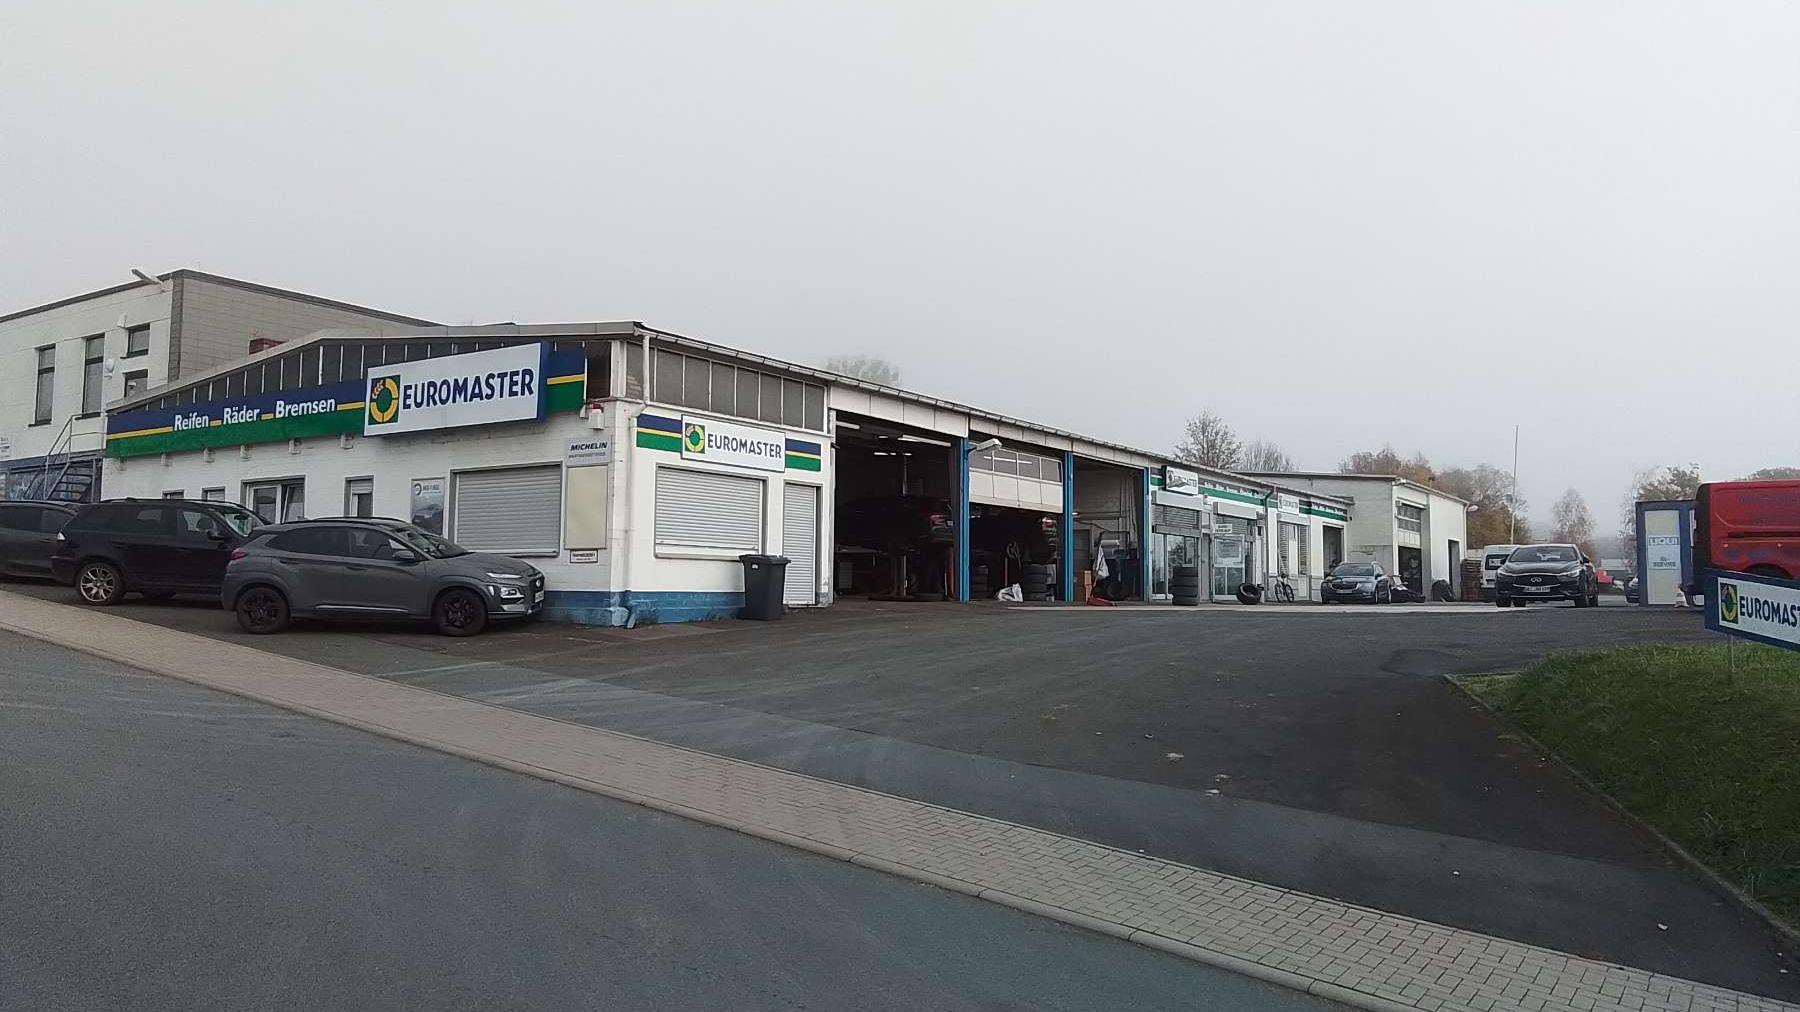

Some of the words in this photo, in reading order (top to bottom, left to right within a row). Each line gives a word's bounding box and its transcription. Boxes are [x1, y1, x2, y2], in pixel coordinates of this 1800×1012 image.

[402, 368, 534, 410] EUROMASTER
[174, 413, 209, 431] Reifen
[222, 405, 260, 425] Räder
[275, 398, 335, 418] Bremsen
[570, 441, 608, 451] MICHELIN
[707, 433, 782, 459] EUROMASTER
